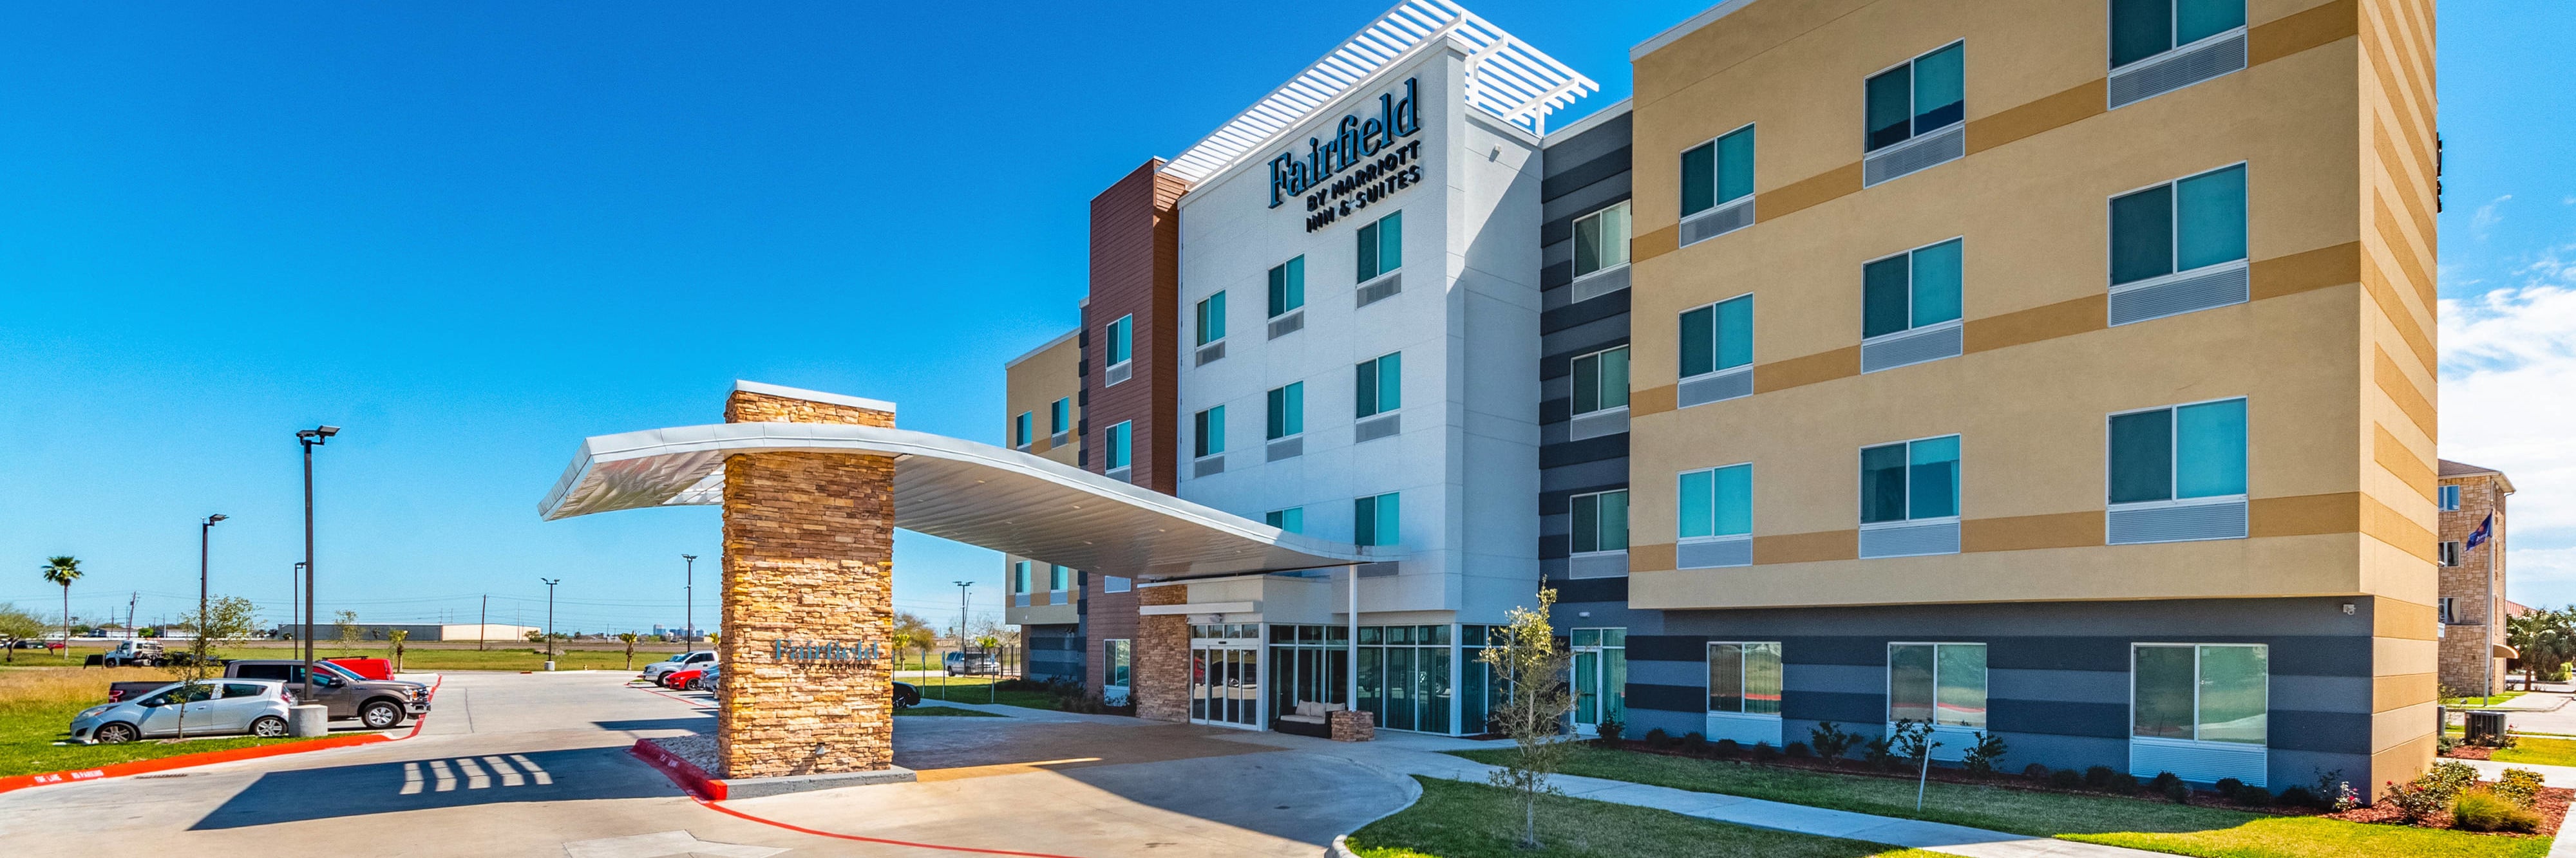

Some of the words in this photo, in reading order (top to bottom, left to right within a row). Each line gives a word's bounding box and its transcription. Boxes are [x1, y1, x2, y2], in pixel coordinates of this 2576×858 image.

[1267, 77, 1421, 209] Fairfield
[1307, 188, 1328, 212] BY
[1331, 140, 1421, 200] MARRIOTT
[1306, 206, 1335, 233] INN
[1339, 199, 1351, 217] &
[1356, 164, 1421, 209] SUITES
[775, 638, 878, 660] Fairfield
